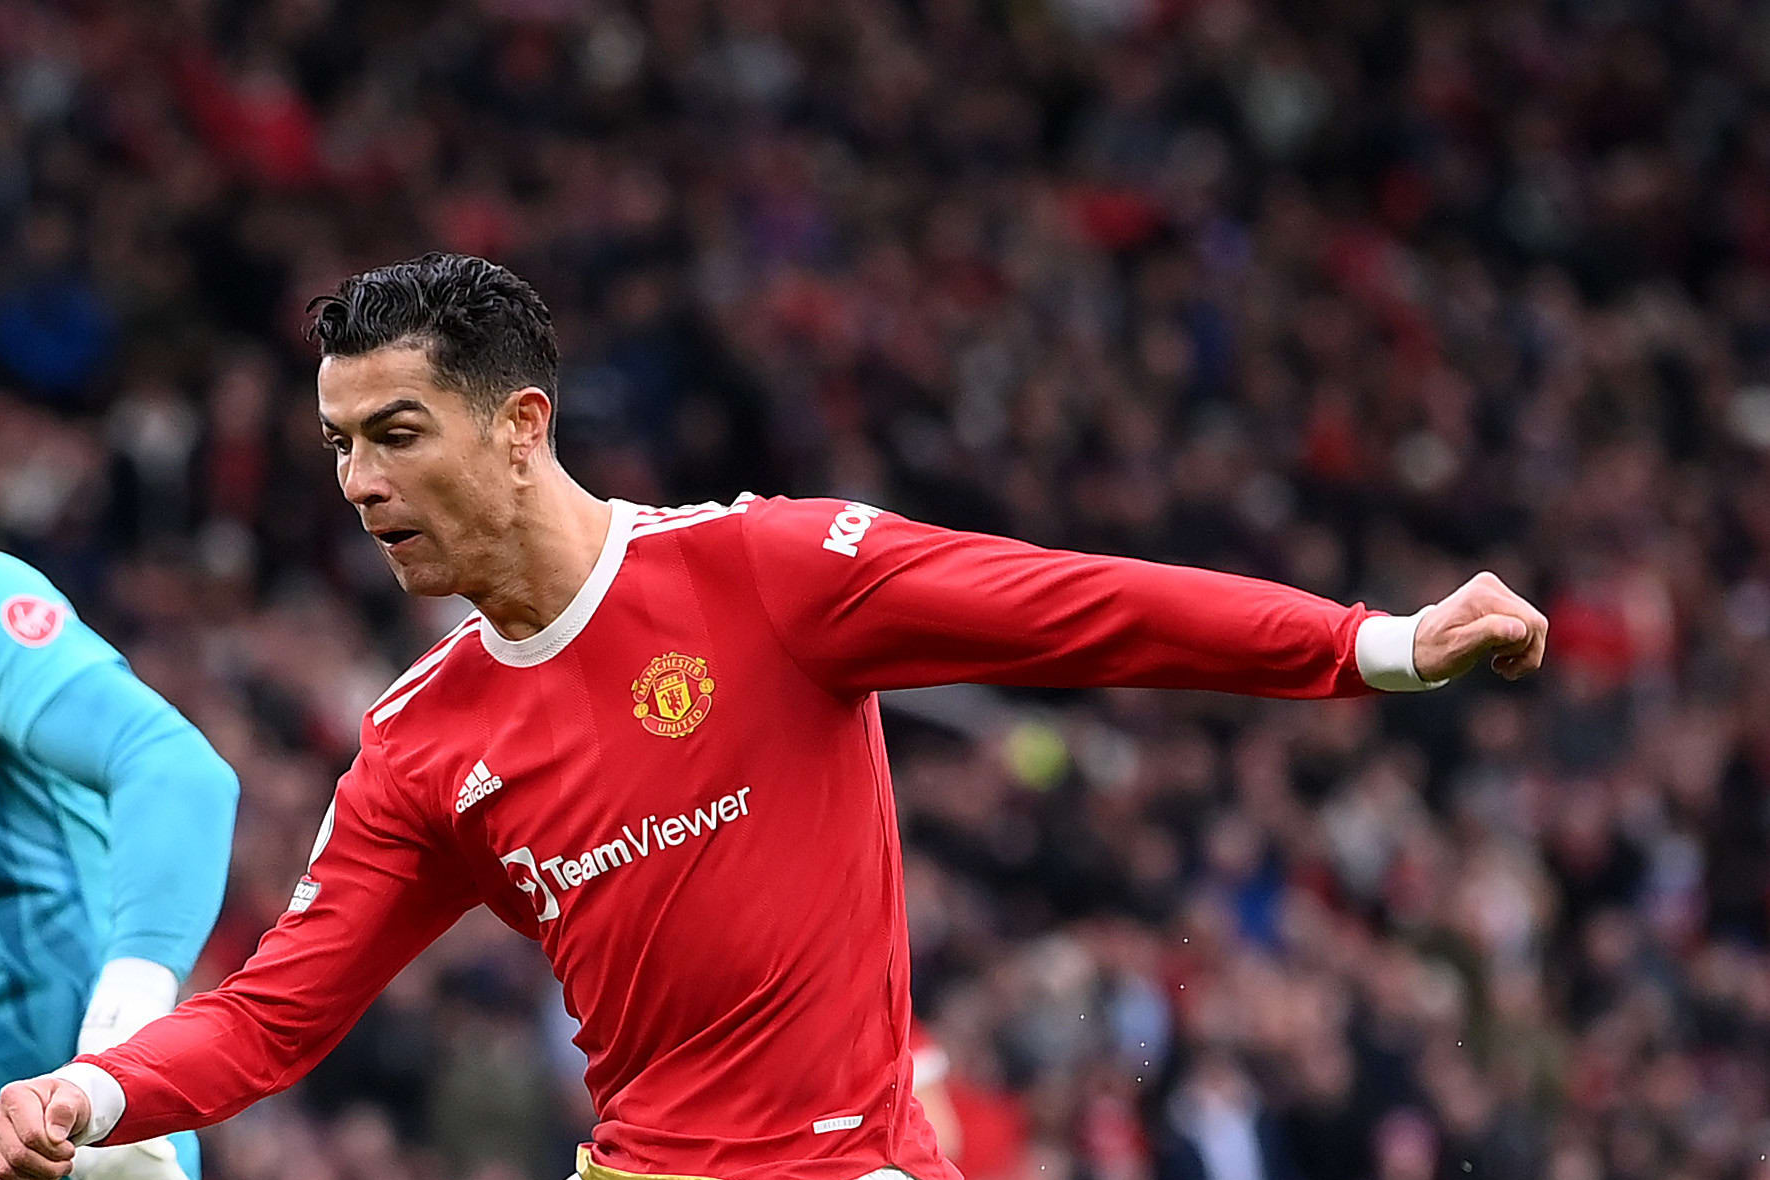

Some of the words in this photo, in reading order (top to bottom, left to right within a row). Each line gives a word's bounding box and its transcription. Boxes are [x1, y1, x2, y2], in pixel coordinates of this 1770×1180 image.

[638, 658, 702, 696] MANCHESTER
[657, 709, 703, 732] UNITED
[455, 775, 503, 813] adidas
[540, 786, 750, 891] TeamViewer
